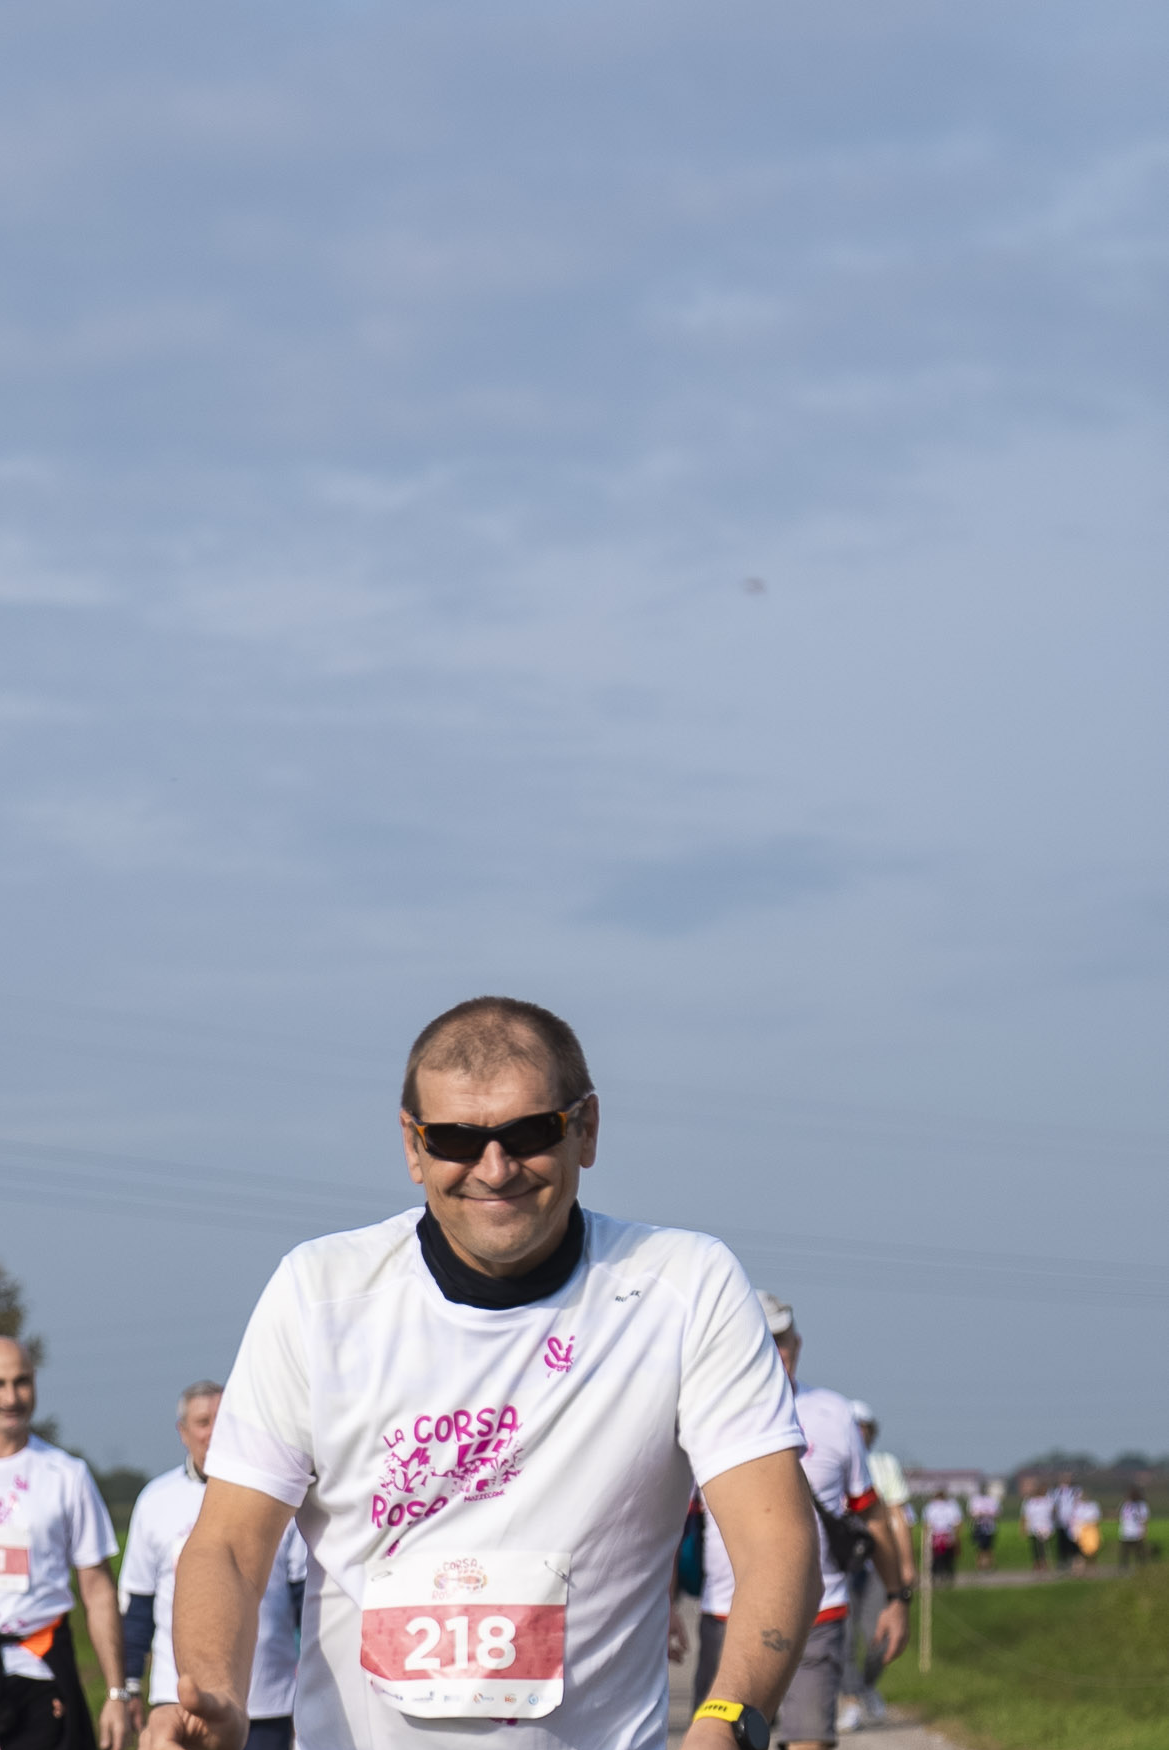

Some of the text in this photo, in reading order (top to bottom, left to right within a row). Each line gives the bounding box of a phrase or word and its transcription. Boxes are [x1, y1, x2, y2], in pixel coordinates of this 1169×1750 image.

[383, 1404, 518, 1449] LA CORSA
[404, 1615, 517, 1672] 218
